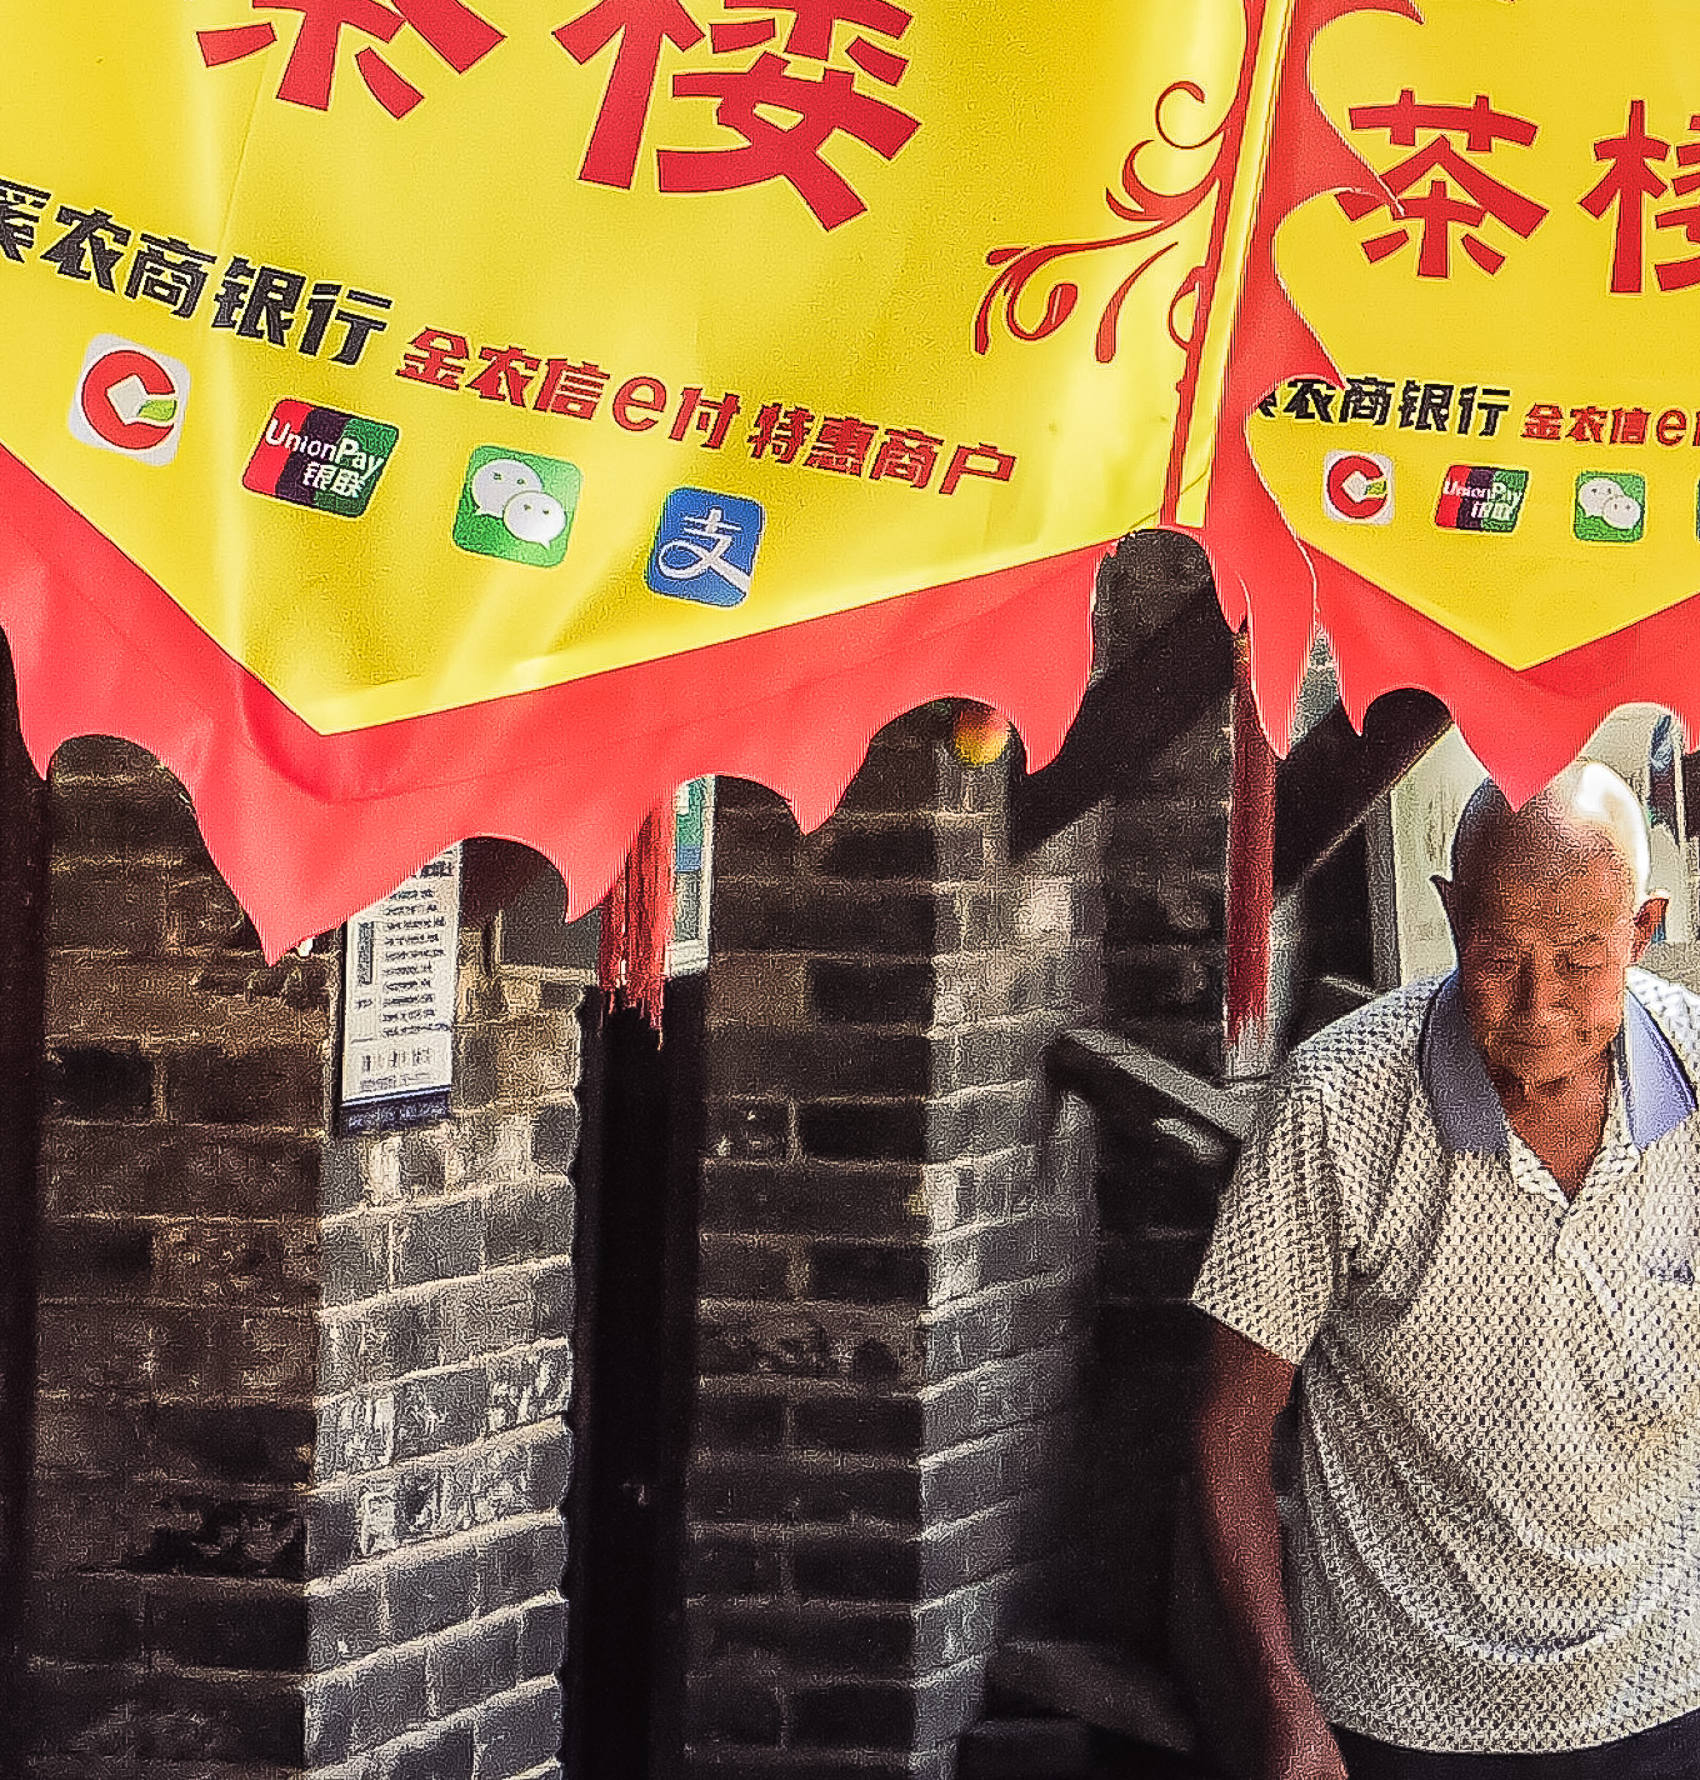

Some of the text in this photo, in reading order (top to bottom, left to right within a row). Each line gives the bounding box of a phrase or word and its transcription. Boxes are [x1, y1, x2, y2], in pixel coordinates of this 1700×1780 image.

[1257, 376, 1511, 438] 农商银行
[266, 418, 385, 481] UnionPay
[749, 403, 1018, 495] 特惠商户
